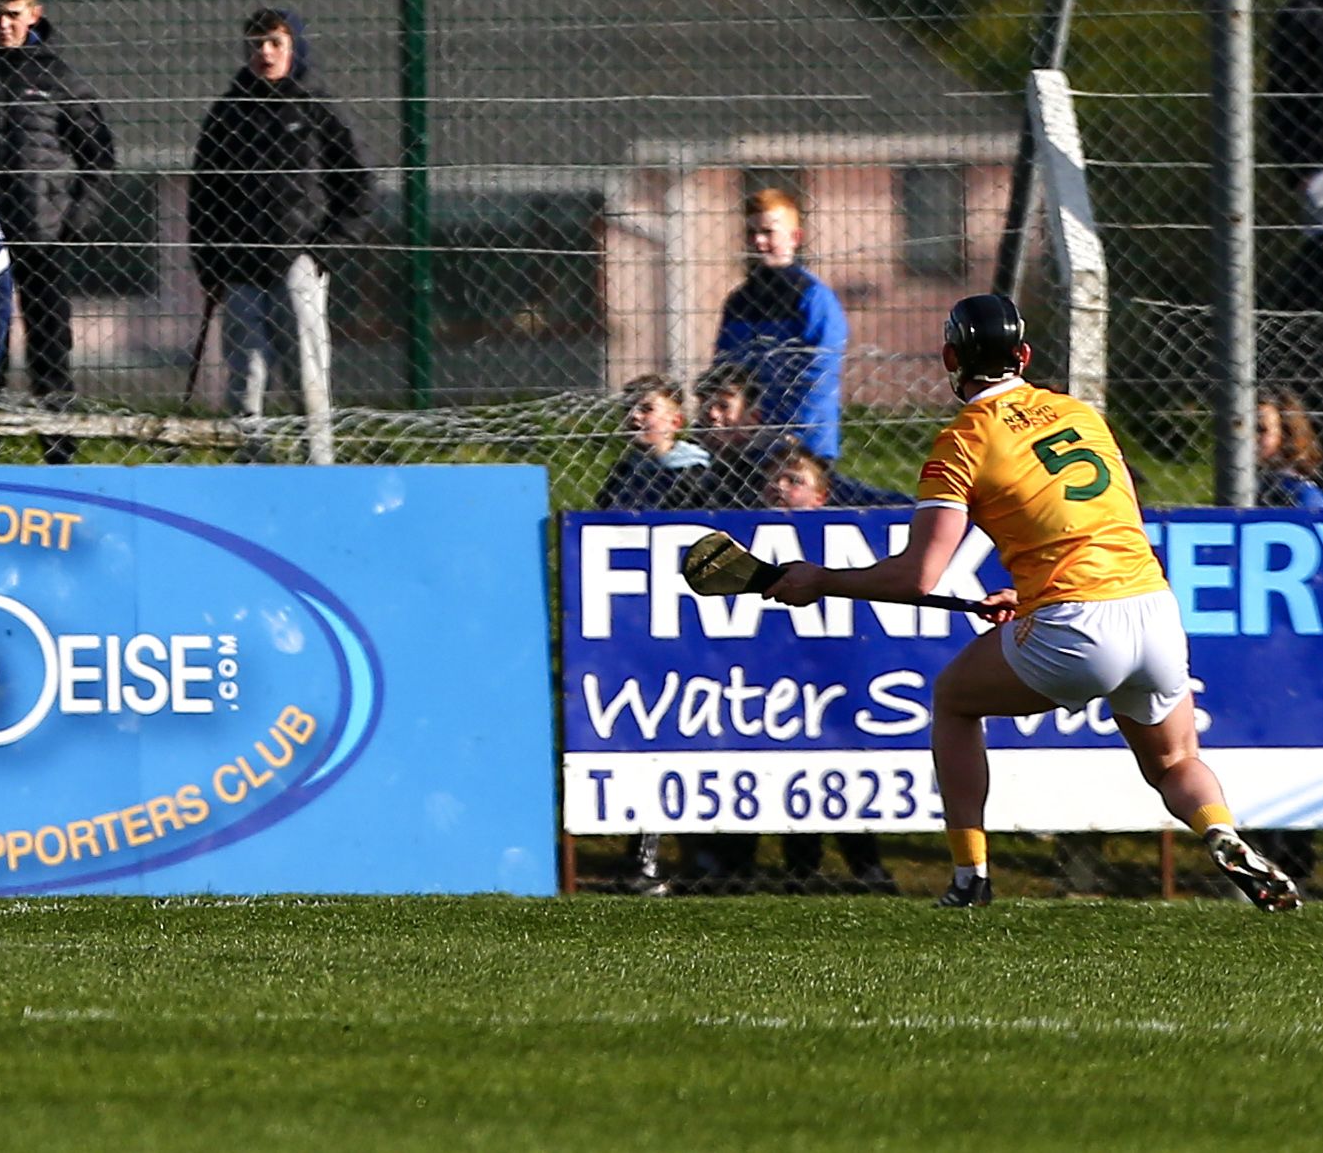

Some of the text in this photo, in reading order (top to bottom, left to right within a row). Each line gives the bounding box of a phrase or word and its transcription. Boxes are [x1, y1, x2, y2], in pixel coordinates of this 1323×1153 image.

[1032, 427, 1111, 501] 5
[582, 666, 847, 740] Water
[212, 704, 317, 804] CLUB
[588, 769, 636, 821] T.
[659, 769, 760, 821] 058
